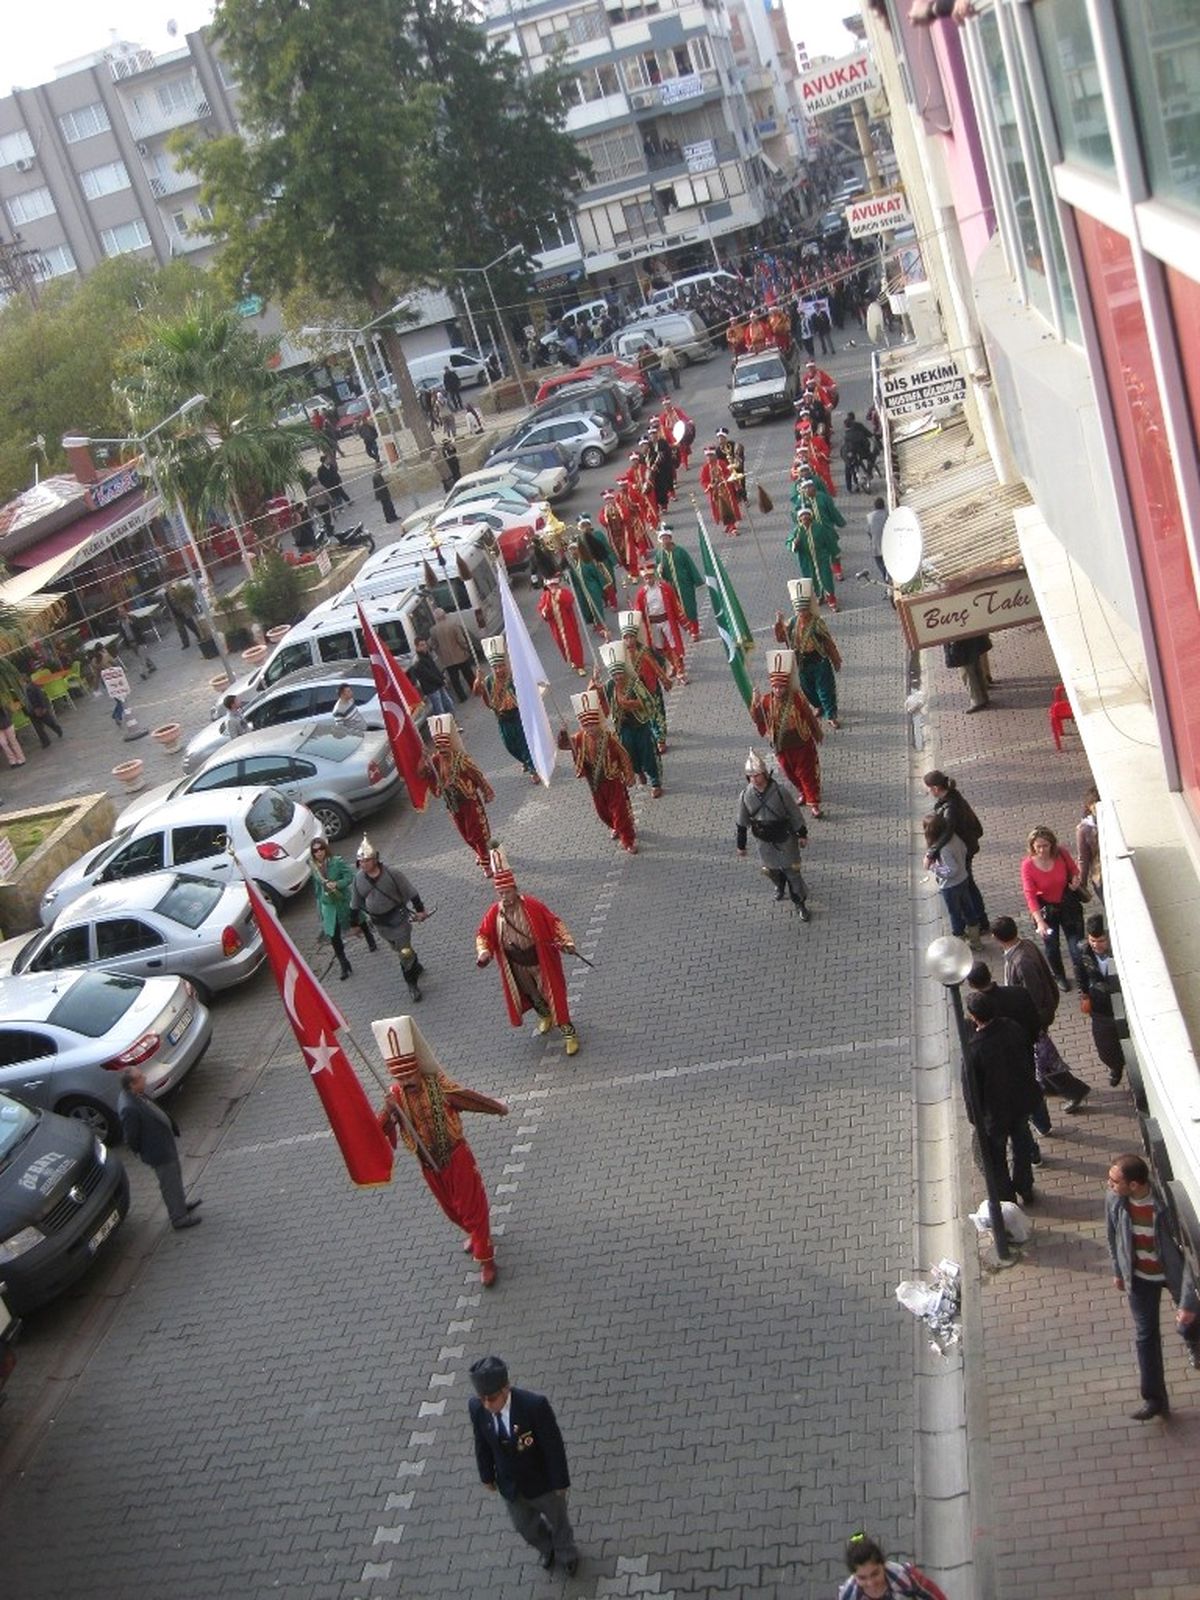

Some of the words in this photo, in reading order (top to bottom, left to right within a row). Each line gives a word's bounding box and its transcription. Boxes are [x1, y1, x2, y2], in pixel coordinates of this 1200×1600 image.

[802, 58, 868, 100] AVUKAT
[837, 79, 877, 101] KARTAL
[851, 198, 902, 222] AVUKAT
[884, 377, 908, 393] DİŞ
[911, 362, 959, 386] HEKİMİ
[891, 405, 912, 417] TEL:
[915, 399, 935, 410] 543
[937, 395, 951, 404] 38
[953, 391, 966, 400] 42
[923, 608, 970, 628] Burç
[972, 588, 1031, 614] Takı
